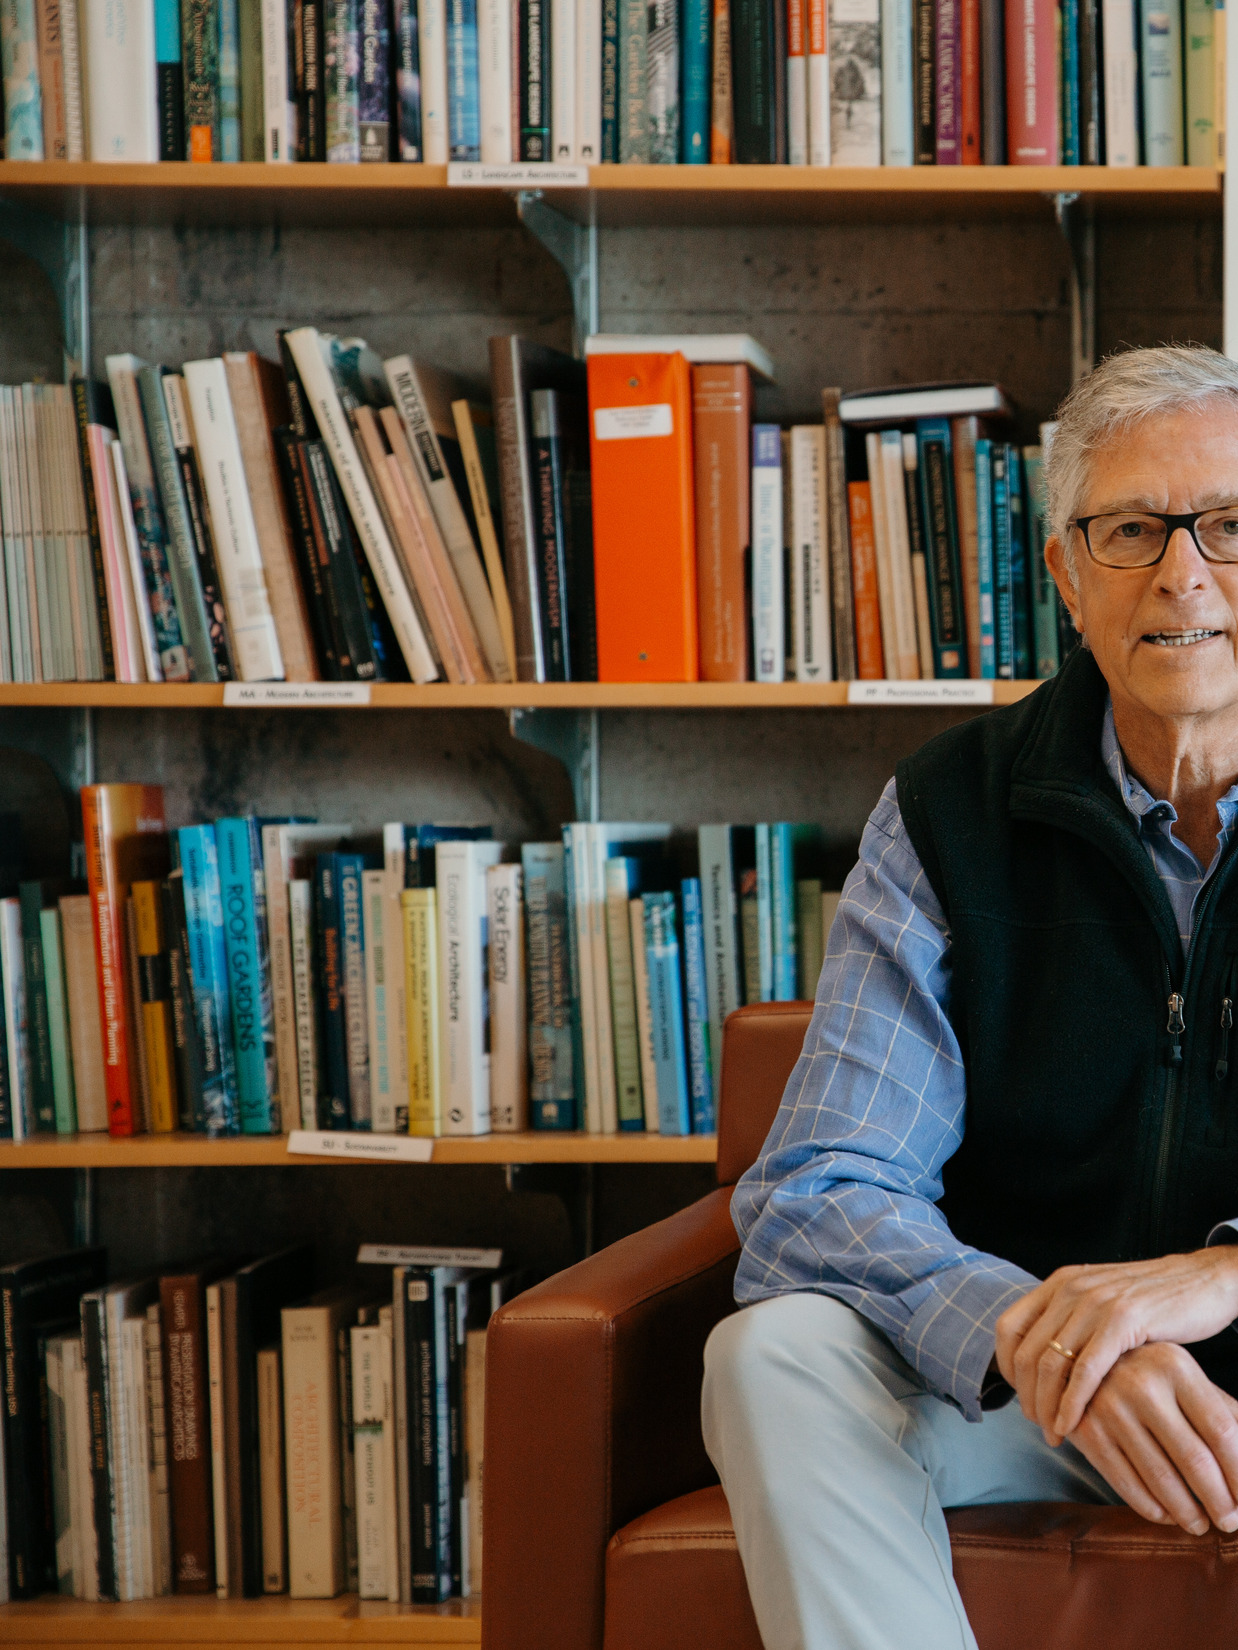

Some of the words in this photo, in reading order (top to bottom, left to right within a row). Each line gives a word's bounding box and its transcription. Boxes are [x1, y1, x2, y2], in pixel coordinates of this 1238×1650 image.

[303, 4, 316, 63] MILLENNIUM
[628, 2, 644, 28] The
[919, 5, 931, 59] Landscape
[364, 37, 378, 83] Garden
[528, 17, 541, 82] LANDSCAPE
[628, 35, 644, 94] Garden
[1024, 27, 1036, 85] LANDSCAPE
[305, 64, 316, 91] PARK
[920, 62, 931, 126] Architecture
[939, 39, 955, 134] LANDSCAPING
[528, 83, 541, 126] DESIGN
[628, 99, 644, 139] Book
[1025, 87, 1036, 126] DESIGN
[394, 369, 428, 431] MODERN
[152, 419, 175, 459] new
[537, 448, 549, 460] A
[161, 460, 184, 502] tech
[536, 465, 556, 535] THRIVING
[165, 502, 196, 569] garden
[361, 520, 399, 597] architecture
[935, 536, 949, 582] CHANGE
[541, 539, 563, 628] MODERNISM
[939, 585, 953, 630] ORDERS
[887, 688, 939, 698] PROFESSIONAL
[942, 688, 976, 698] PRACTICE
[96, 892, 106, 903] in
[225, 883, 248, 946] ROOF
[342, 875, 358, 937] GREEN
[445, 873, 460, 936] Ecological
[494, 887, 511, 924] Solar
[710, 863, 723, 919] Technics
[97, 904, 112, 966] Architecture
[194, 932, 208, 980] Construction
[492, 929, 511, 985] Energy
[714, 924, 724, 948] and
[102, 966, 113, 987] and
[167, 949, 180, 988] Planning
[447, 940, 460, 1022] Architecture
[716, 952, 729, 1029] Architectu
[103, 988, 116, 1020] Urban
[171, 997, 185, 1048] Biodiversity
[230, 949, 257, 1052] GARDENS
[103, 1020, 120, 1066] Planning
[300, 1048, 311, 1097] GREEN
[0, 1288, 14, 1348] Architectural
[172, 1288, 187, 1329] KEMPER
[3, 1350, 16, 1394] Teaching
[179, 1332, 195, 1405] PRESENTATION
[362, 1351, 370, 1370] THE
[419, 1340, 430, 1394] architecture
[6, 1396, 16, 1417] USA
[362, 1373, 371, 1411] WORLD
[421, 1397, 431, 1415] and
[170, 1406, 185, 1461] ARCHITECTS
[184, 1406, 198, 1460] DRAWINGS
[290, 1394, 307, 1513] COMPOSITION
[303, 1381, 322, 1528] ARCHITECTURAL
[420, 1416, 432, 1465] computers
[366, 1442, 374, 1488] WITHOUT
[366, 1491, 375, 1505] US
